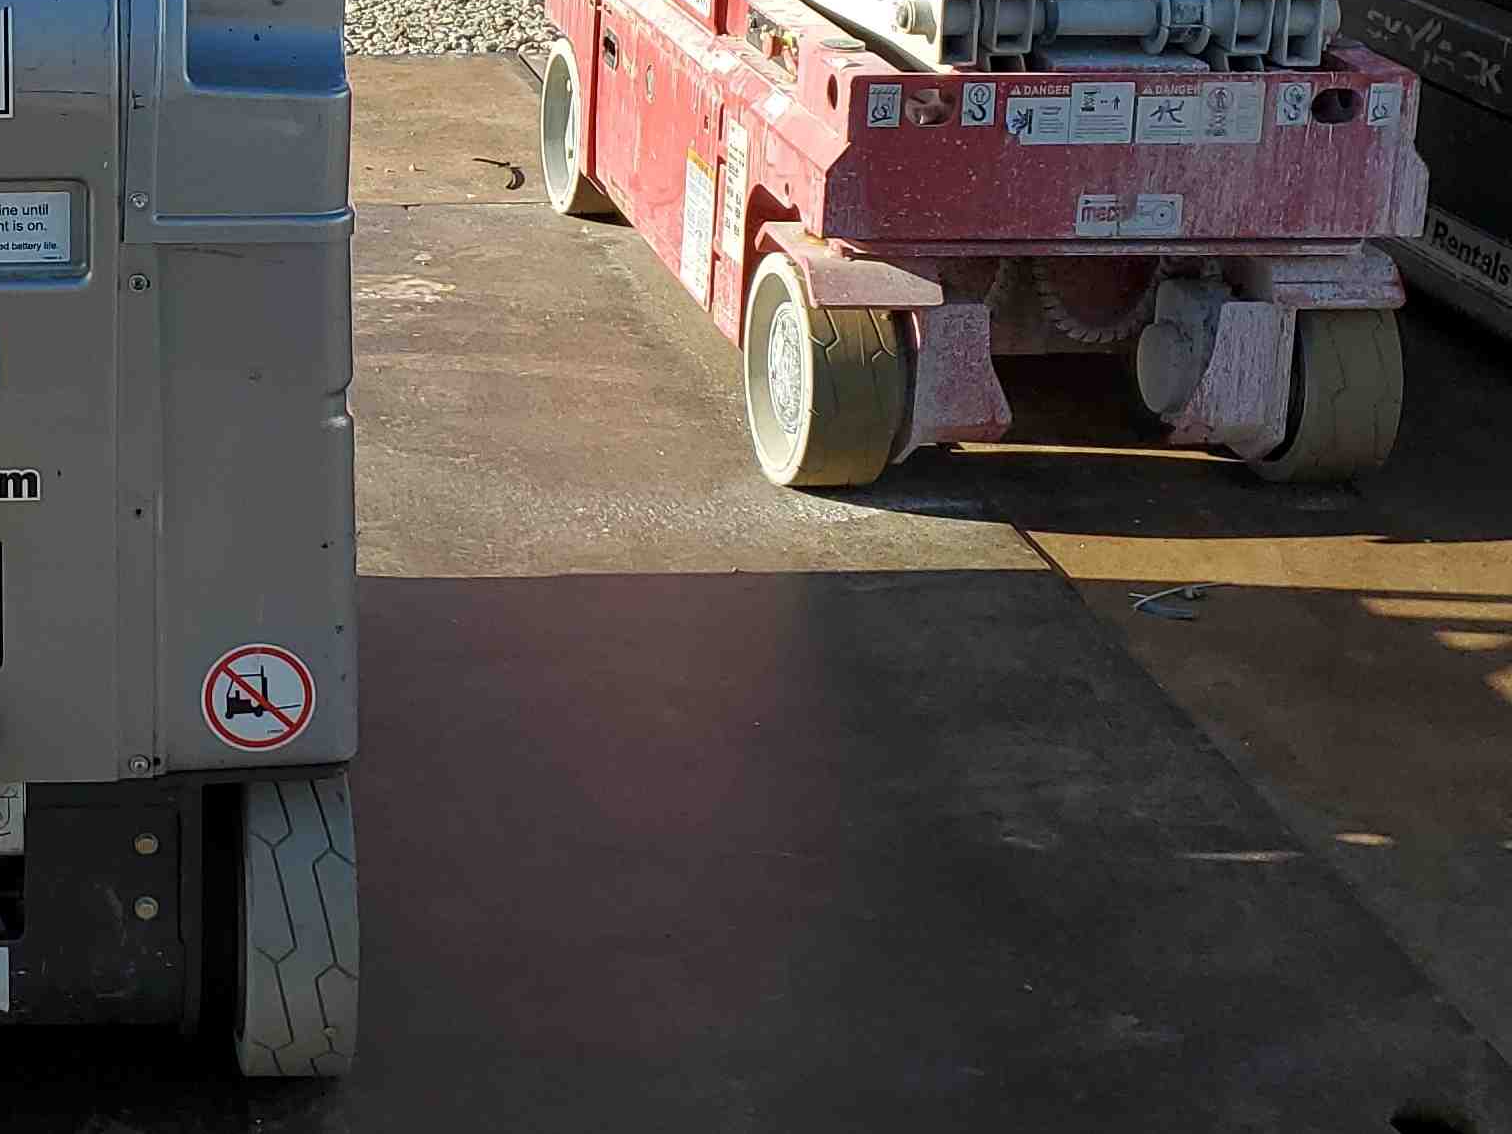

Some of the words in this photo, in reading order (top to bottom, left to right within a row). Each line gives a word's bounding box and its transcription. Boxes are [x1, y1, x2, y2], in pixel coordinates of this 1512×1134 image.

[1023, 85, 1071, 96] DANGER
[21, 203, 49, 216] until
[12, 219, 24, 232] is
[27, 221, 48, 232] on.
[11, 241, 42, 252] battery
[1431, 219, 1510, 286] Rentals
